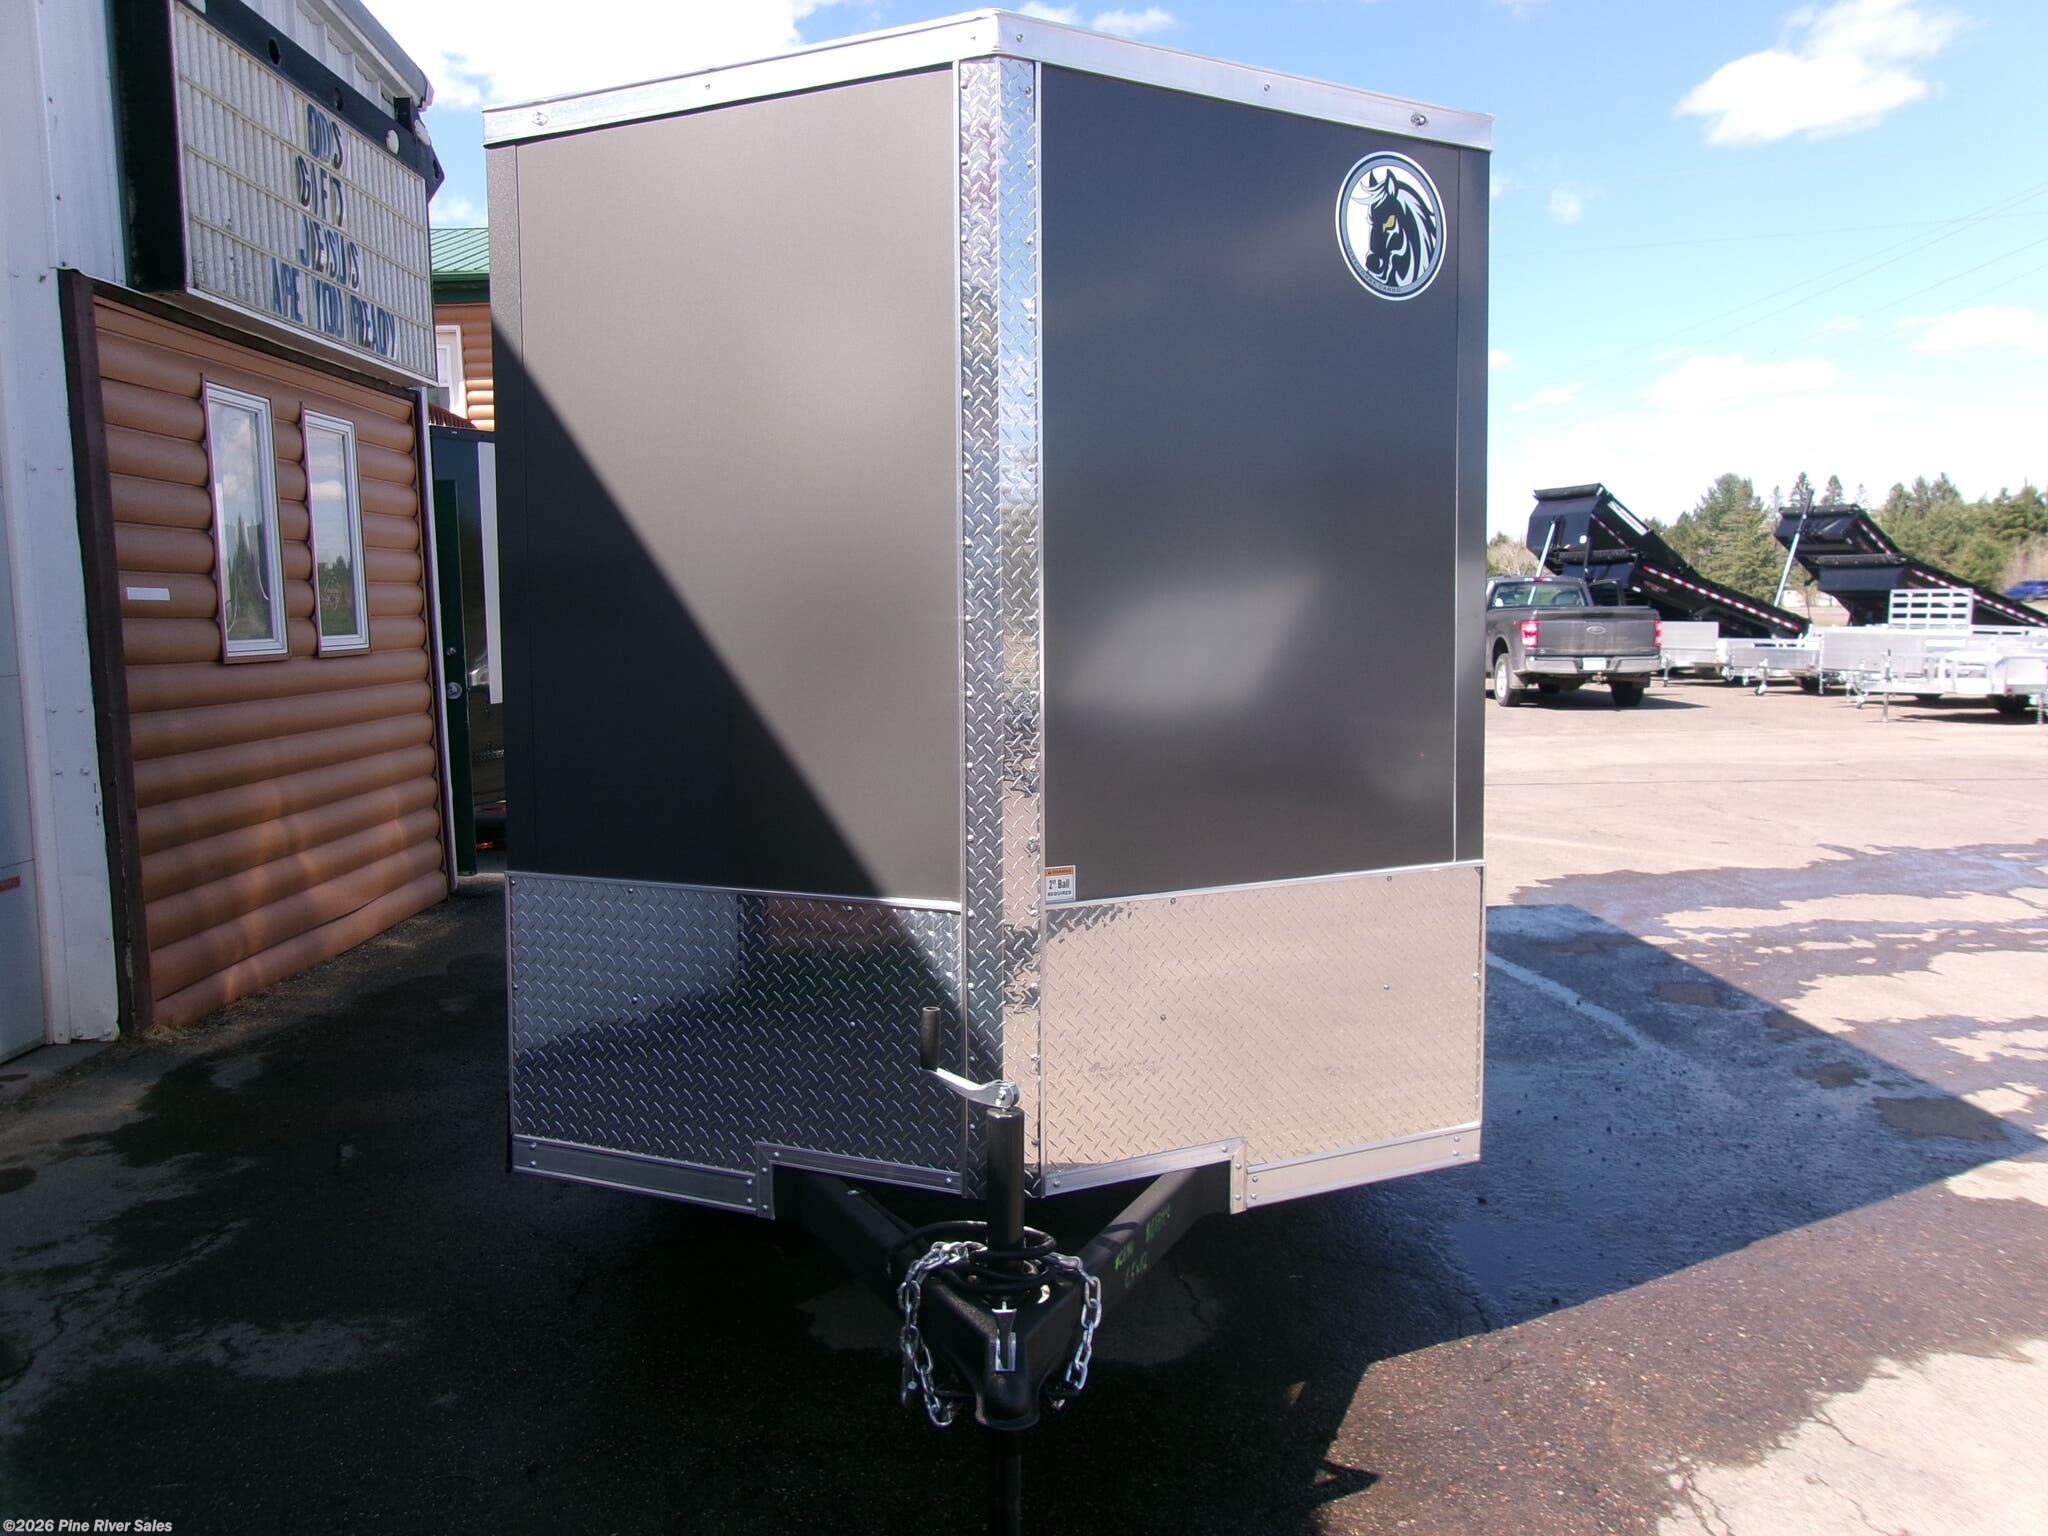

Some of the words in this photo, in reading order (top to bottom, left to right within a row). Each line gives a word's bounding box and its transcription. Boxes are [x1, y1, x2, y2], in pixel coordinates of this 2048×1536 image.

[300, 214, 360, 289] JESUS
[271, 256, 303, 322] ARE
[311, 276, 345, 339] YOU
[350, 295, 397, 358] READY
[1058, 878, 1070, 888] Ball
